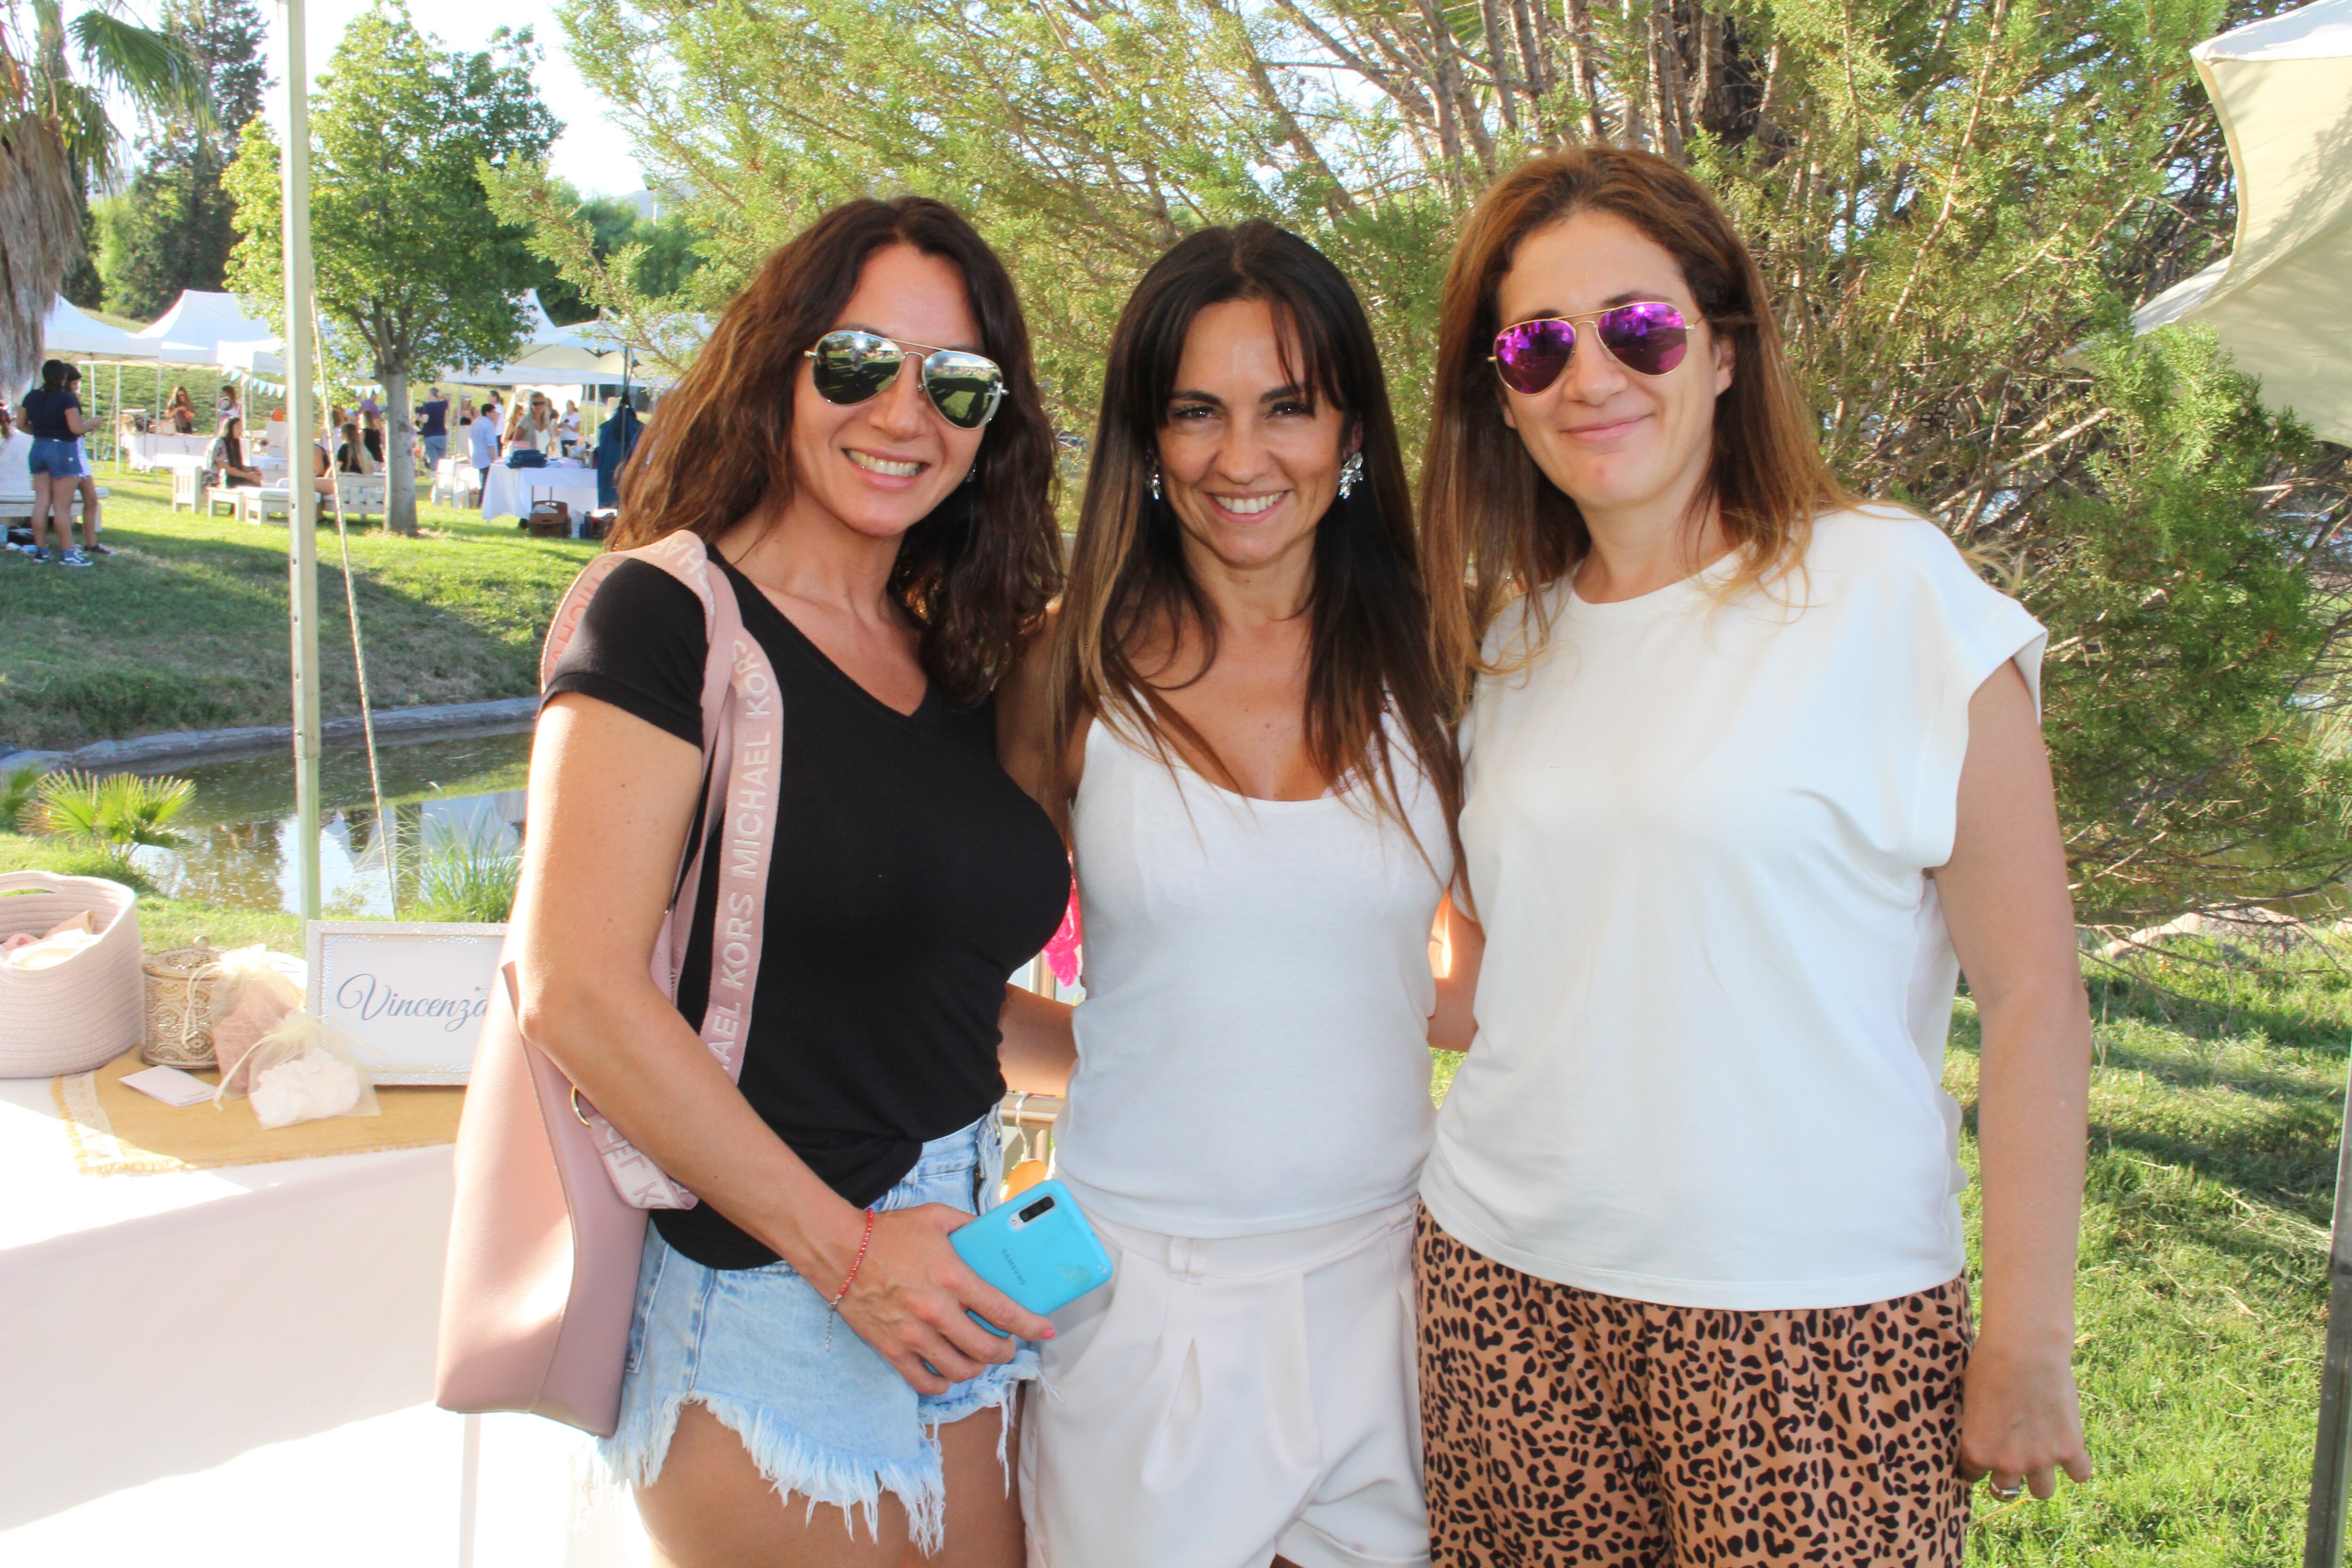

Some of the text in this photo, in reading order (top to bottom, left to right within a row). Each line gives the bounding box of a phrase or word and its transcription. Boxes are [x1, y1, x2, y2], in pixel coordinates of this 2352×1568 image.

[731, 731, 771, 879] MICHAEL
[720, 892, 755, 990] KORS
[1001, 1249, 1026, 1286] SAMSUNG
